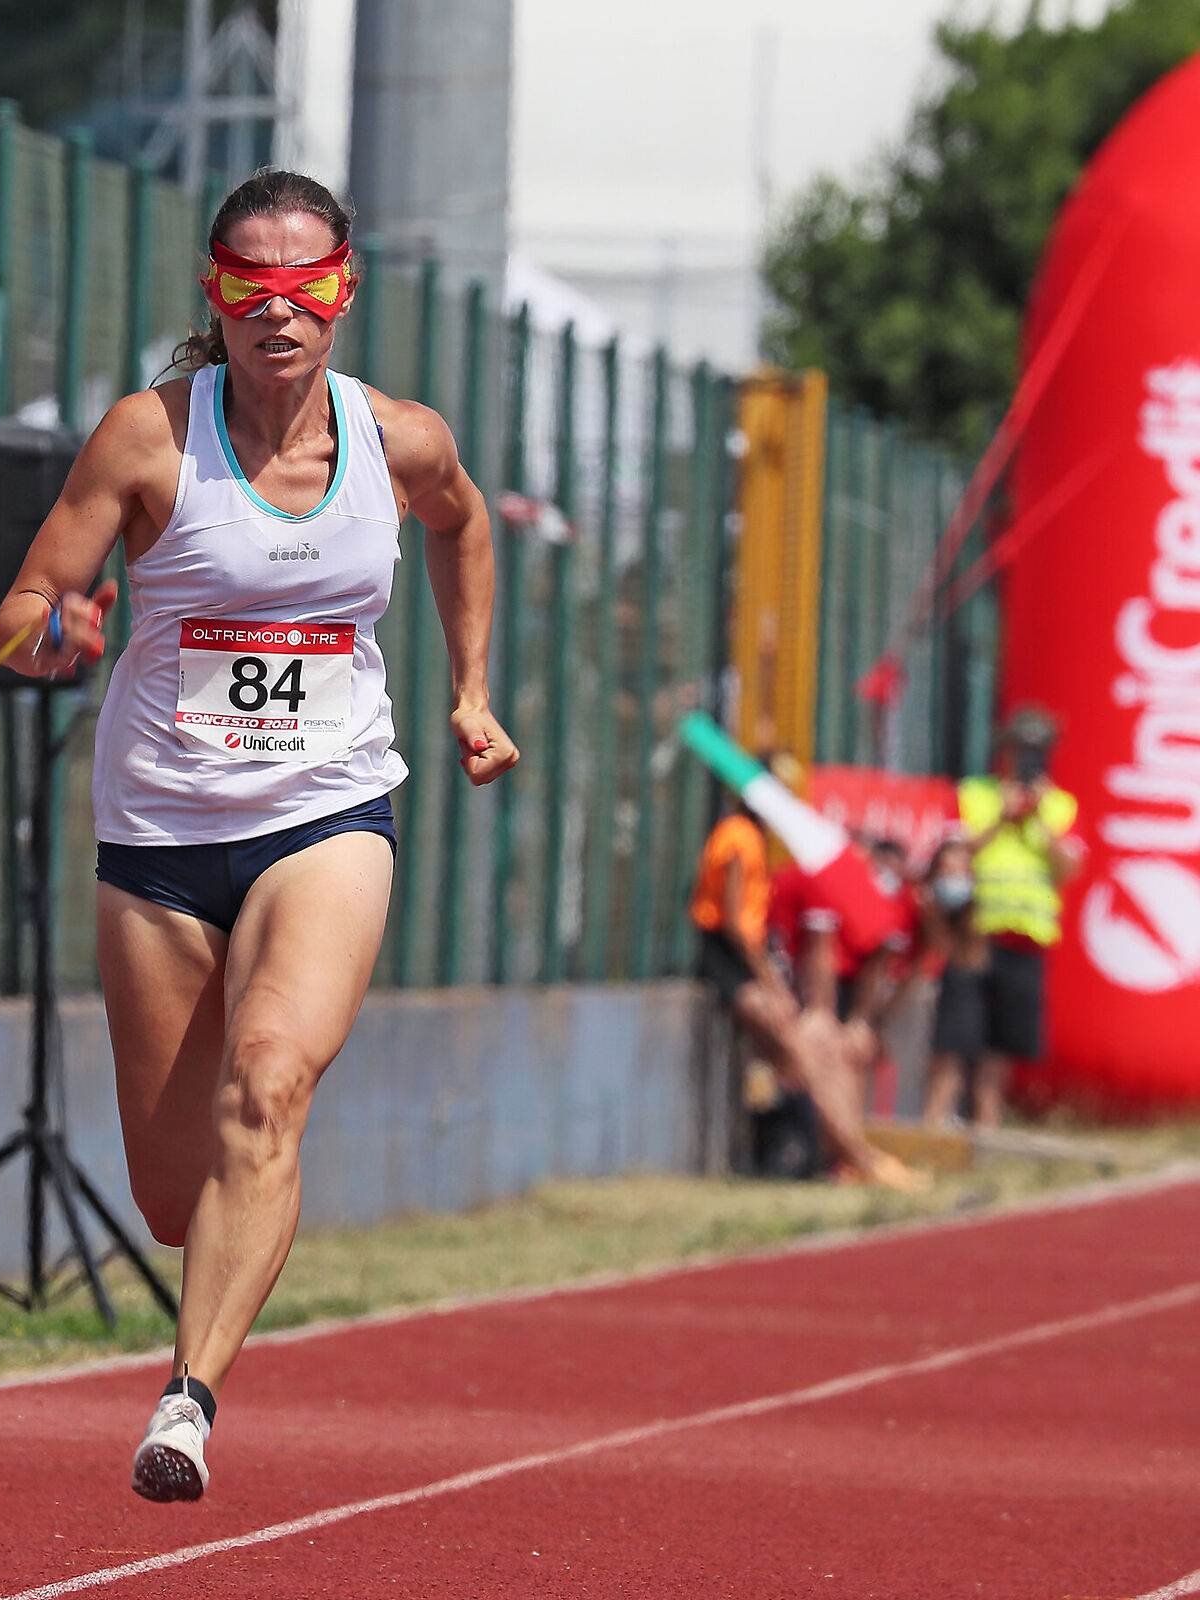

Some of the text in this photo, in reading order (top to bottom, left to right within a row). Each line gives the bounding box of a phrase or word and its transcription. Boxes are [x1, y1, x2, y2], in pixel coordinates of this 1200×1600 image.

[268, 541, 320, 562] diadora
[228, 655, 306, 713] 84
[182, 713, 297, 730] CONCESIO 2021
[243, 734, 306, 751] UniCredit
